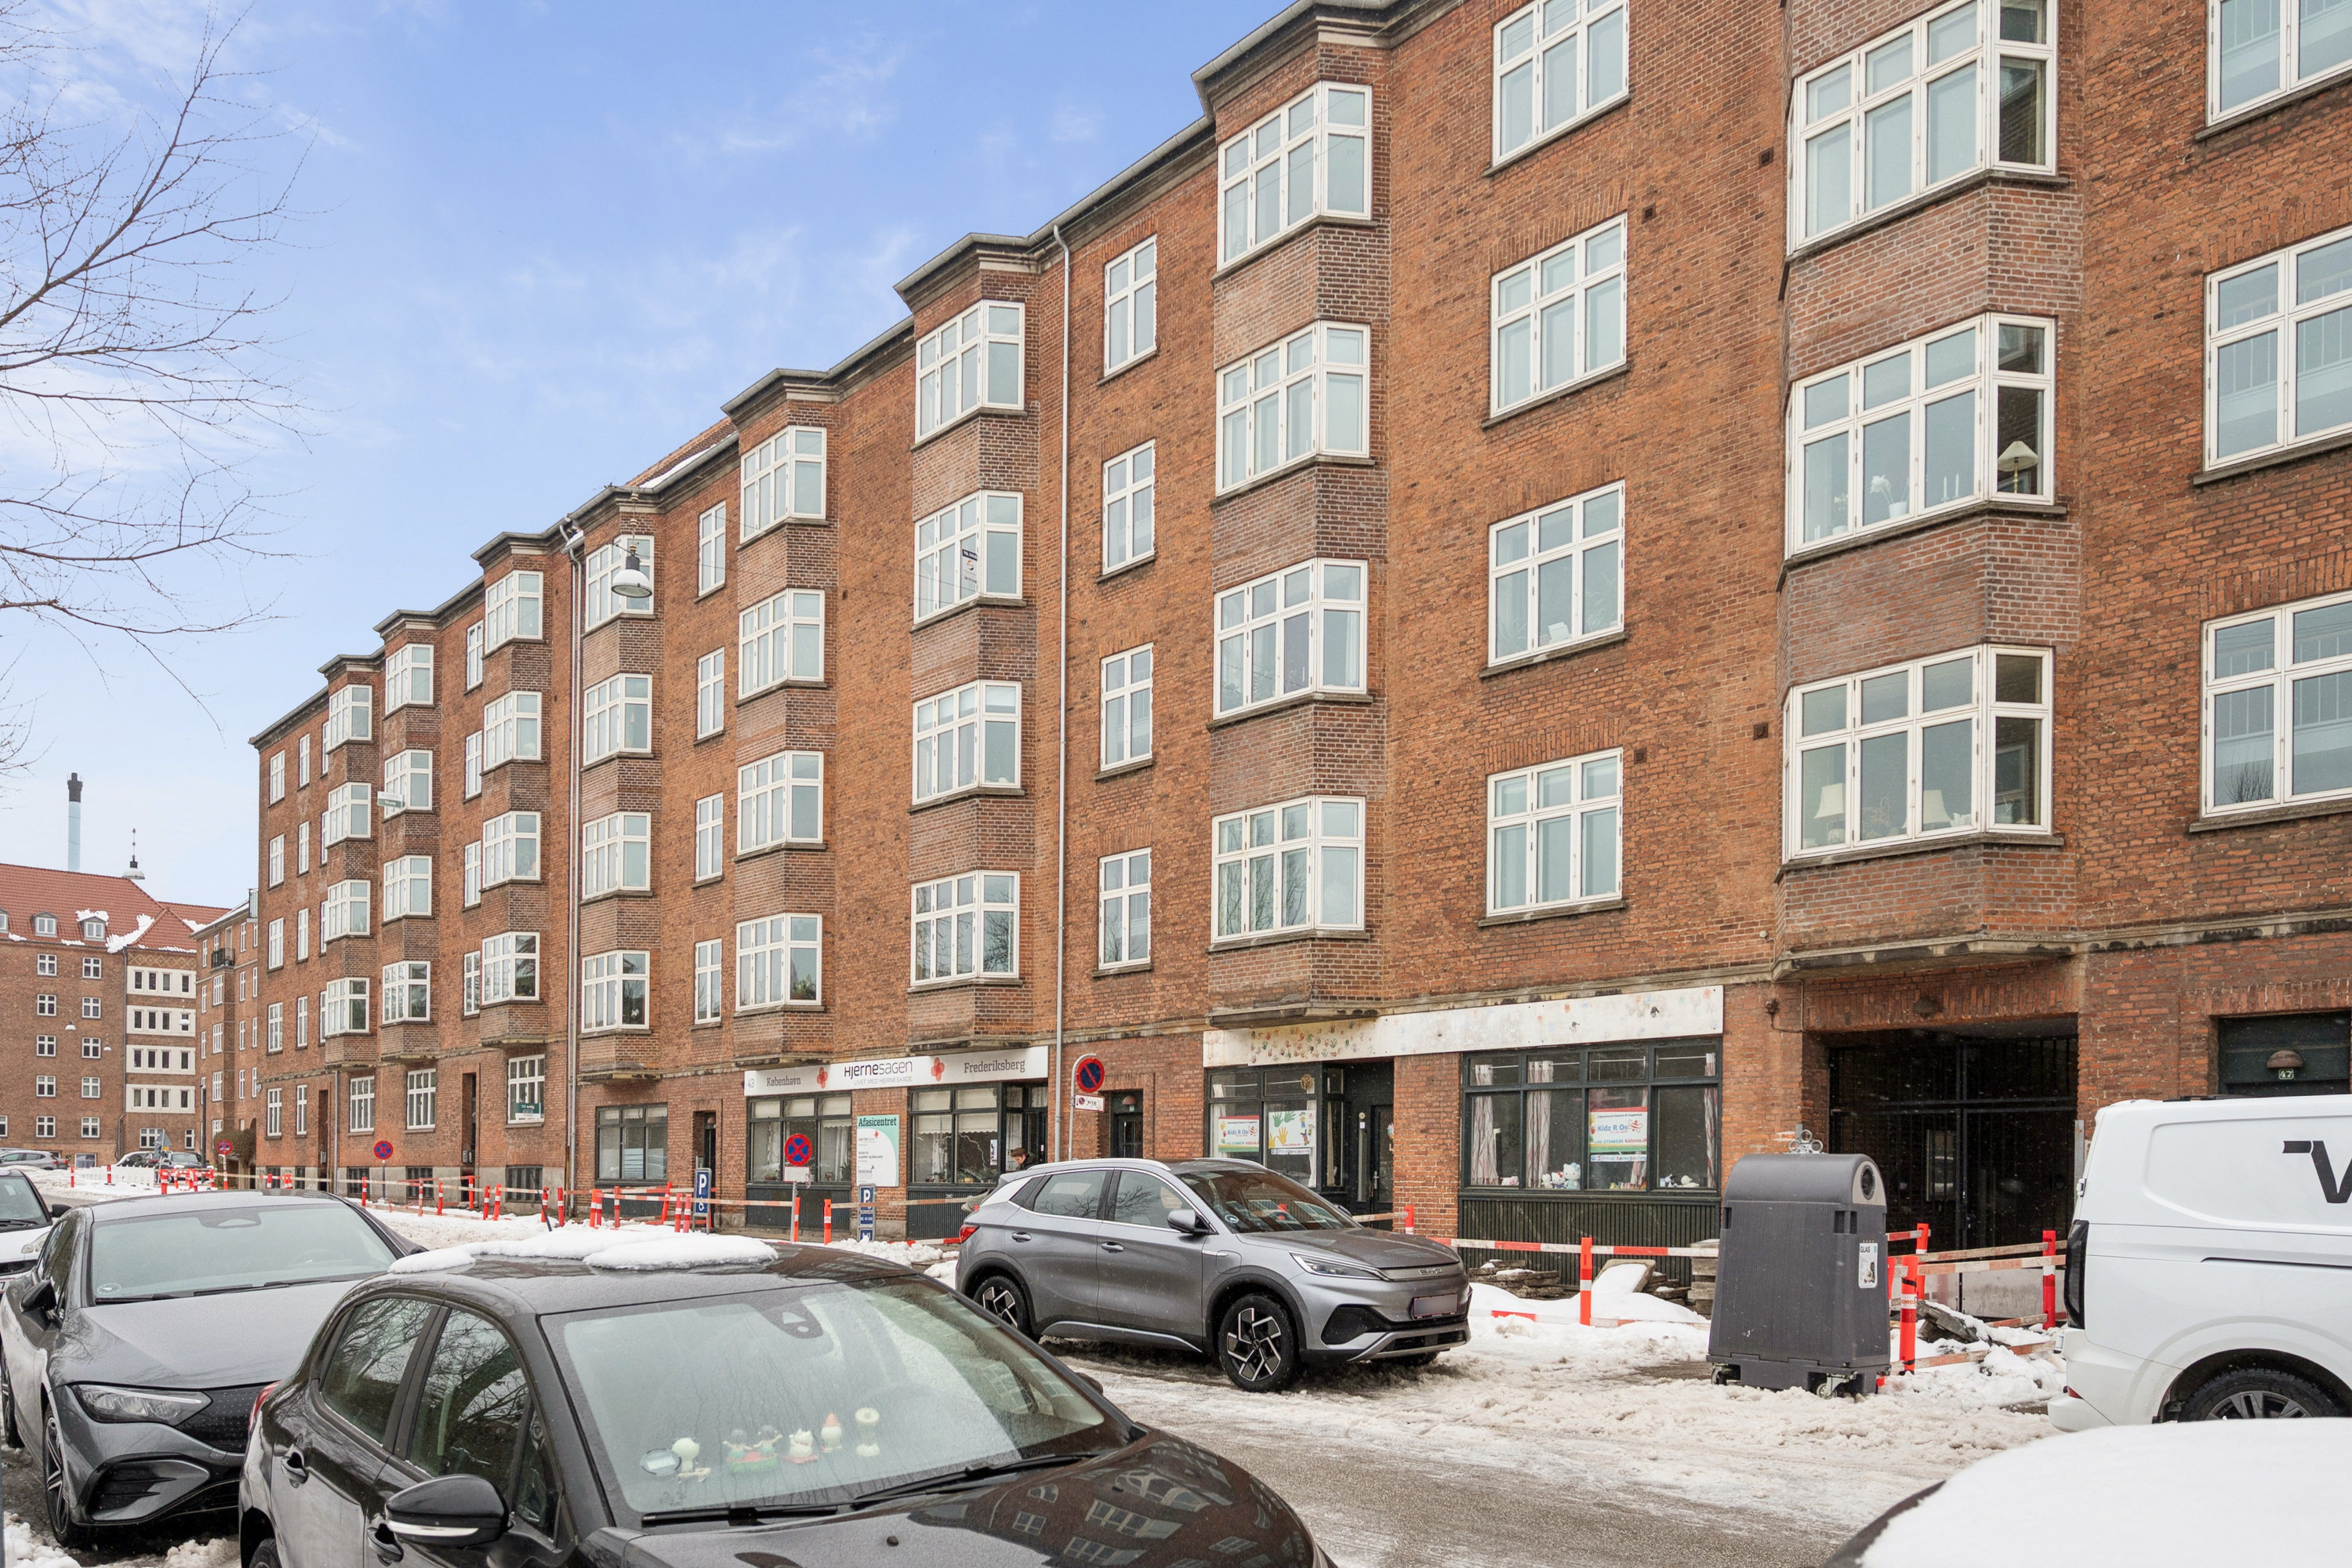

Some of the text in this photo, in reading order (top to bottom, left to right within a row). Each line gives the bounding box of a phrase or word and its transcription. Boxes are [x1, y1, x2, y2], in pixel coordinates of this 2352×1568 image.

[964, 1059, 1025, 1073] Frederiksberg
[747, 1079, 755, 1088] 43
[766, 1075, 801, 1087] København
[879, 1076, 913, 1085] HJERNESKADE
[858, 1117, 897, 1127] Afasicentret
[699, 1174, 707, 1195] P
[863, 1189, 870, 1203] P
